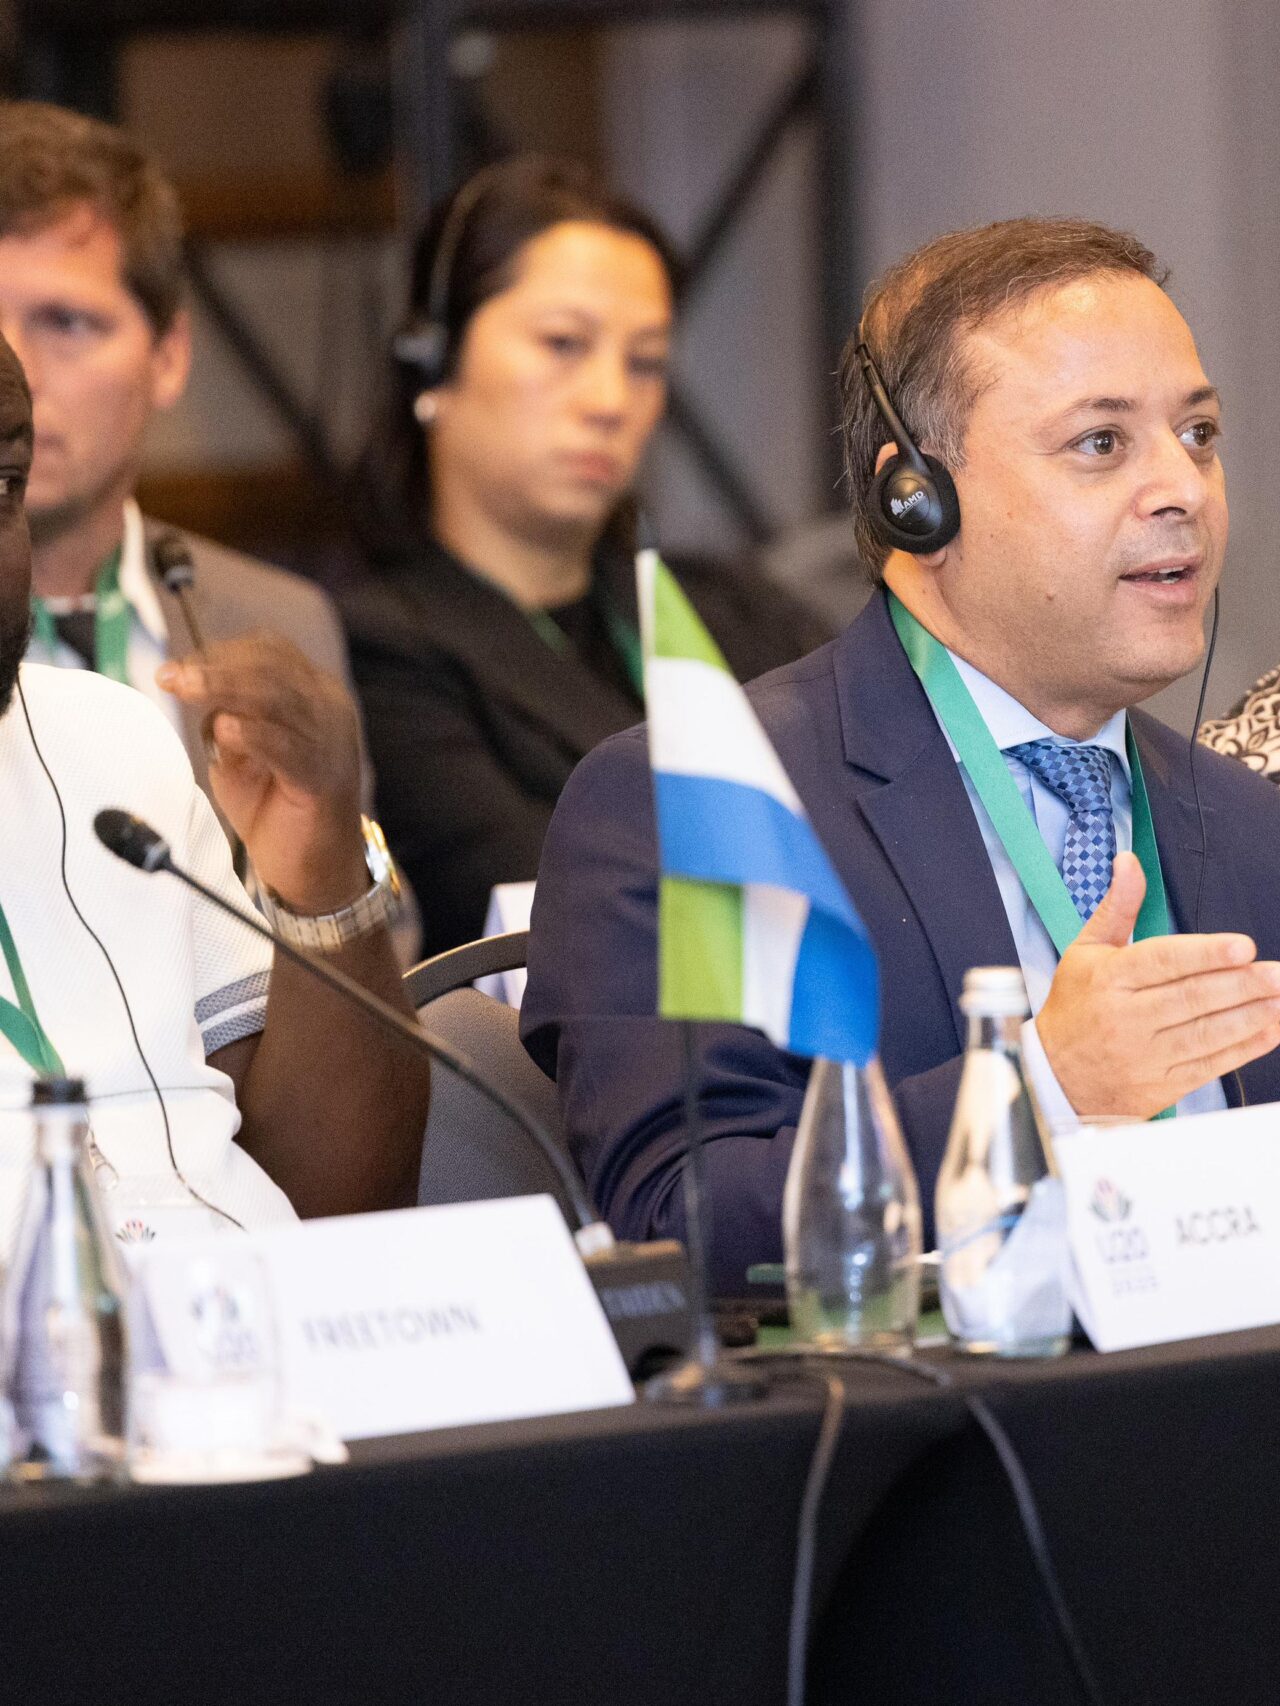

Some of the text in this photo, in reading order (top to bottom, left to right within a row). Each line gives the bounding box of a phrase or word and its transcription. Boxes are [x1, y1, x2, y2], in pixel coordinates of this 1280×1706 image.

[903, 491, 924, 510] AMD
[1176, 1206, 1260, 1245] ACCRA
[301, 1302, 482, 1350] FREETOWN
